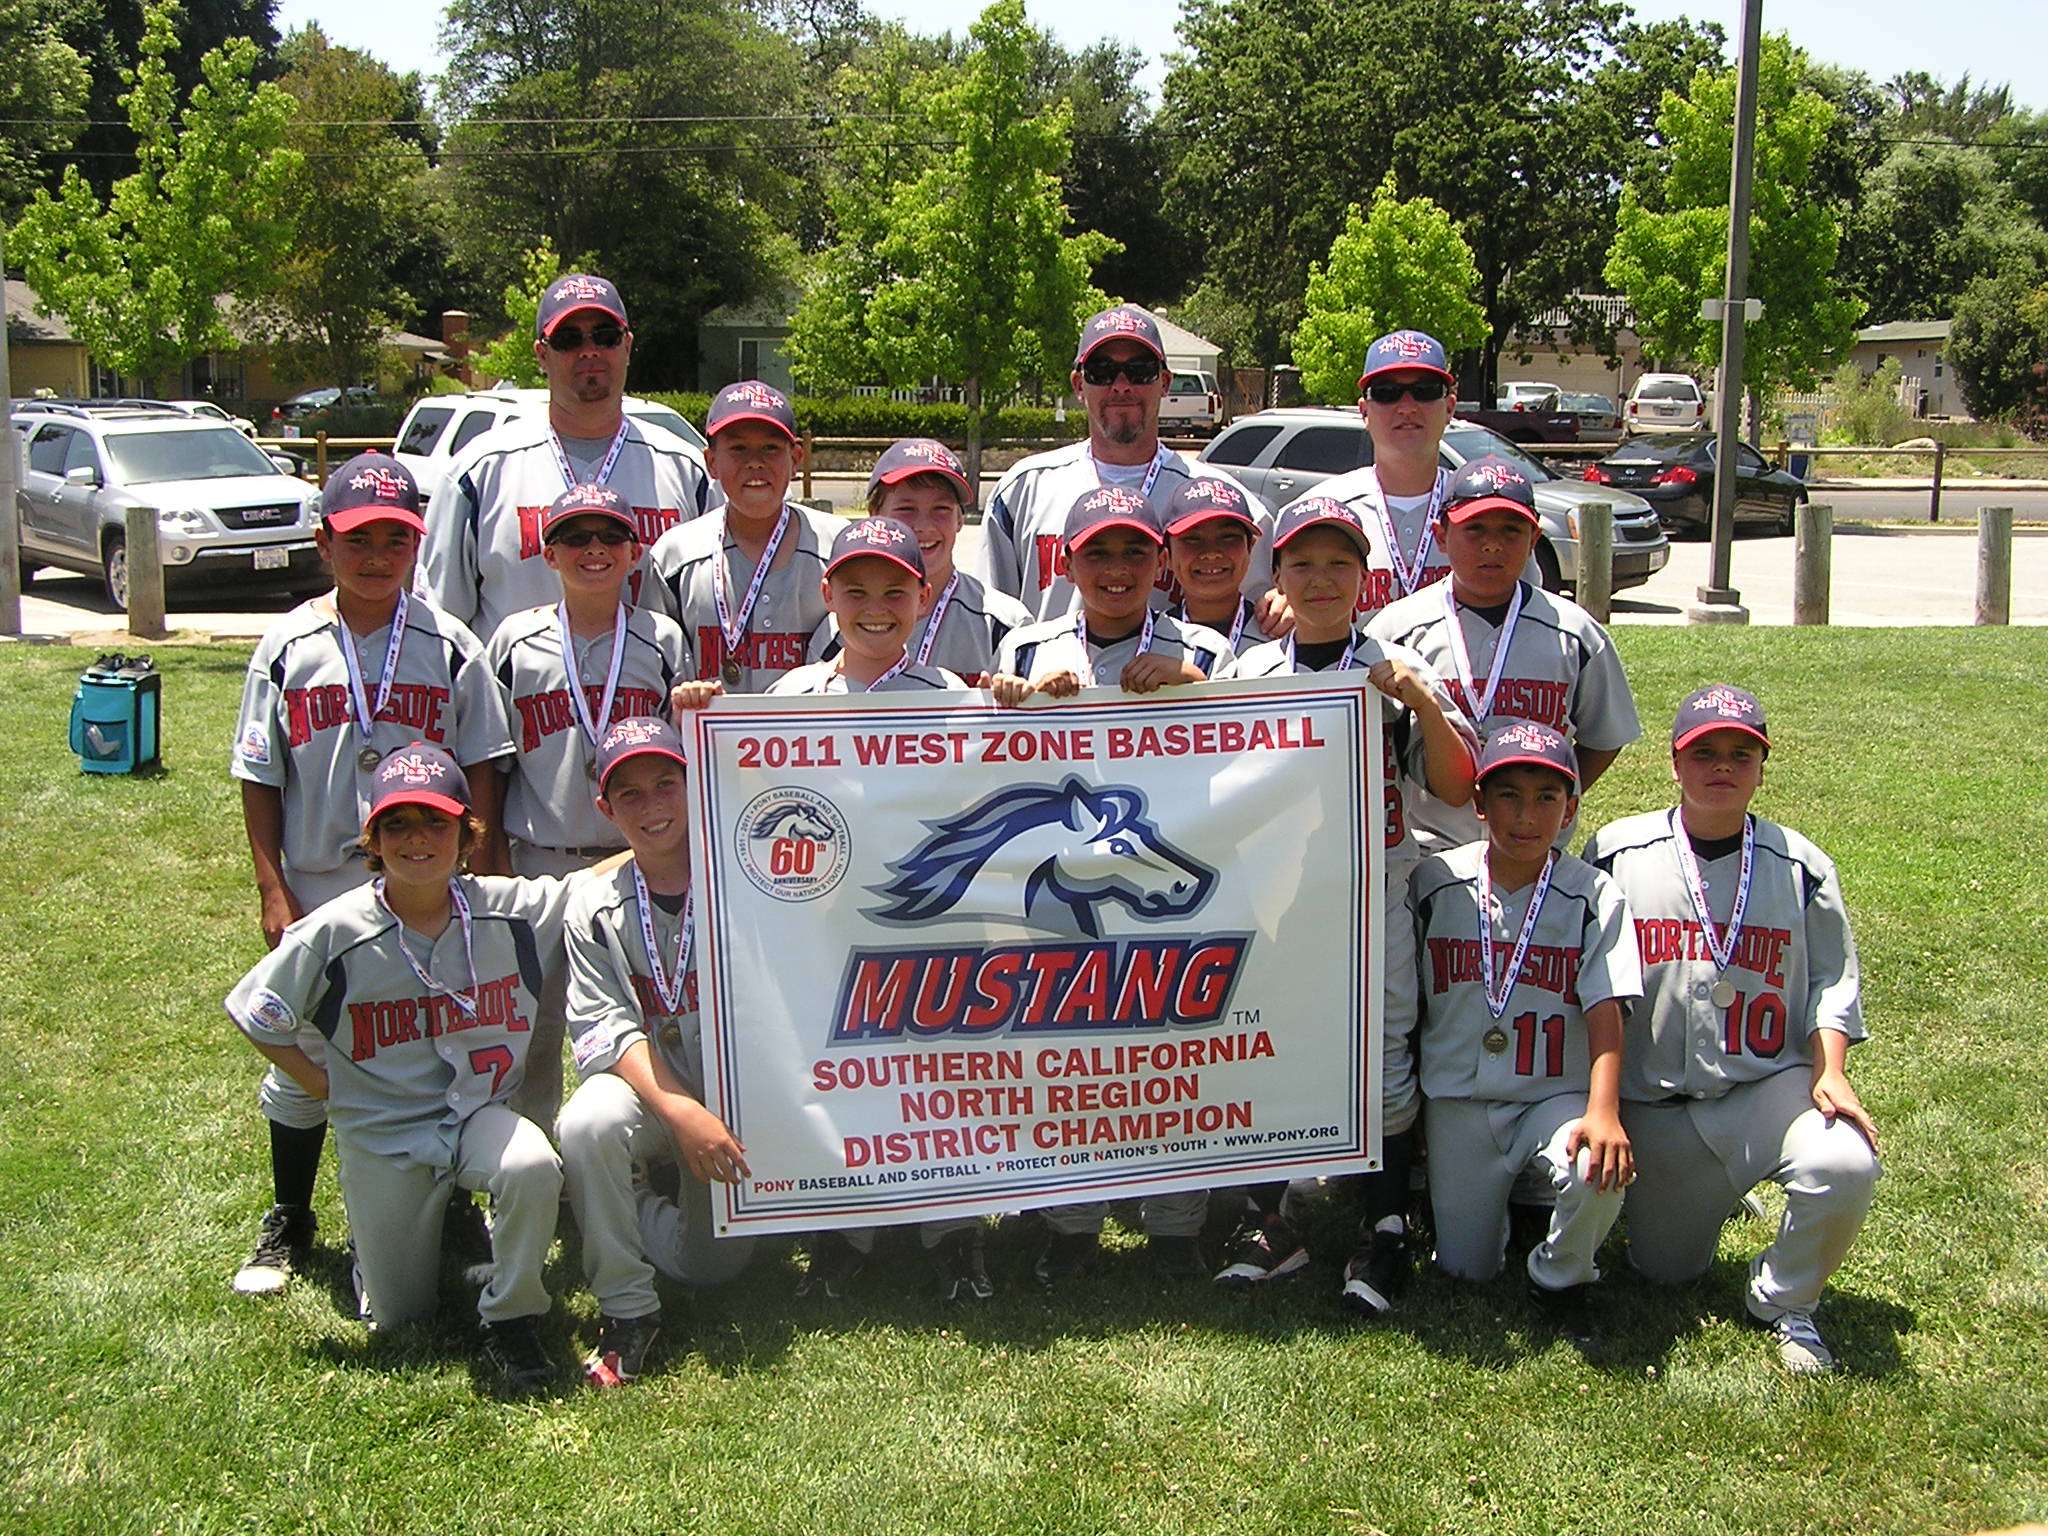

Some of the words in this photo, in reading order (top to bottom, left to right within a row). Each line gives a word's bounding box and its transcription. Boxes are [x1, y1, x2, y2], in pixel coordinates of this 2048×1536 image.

[242, 508, 281, 521] GMC
[283, 684, 450, 748] NORHSIDE
[737, 735, 841, 768] 2011
[852, 732, 969, 766] WEST
[981, 729, 1095, 763] ZONE
[1107, 716, 1326, 760] BASEBALL
[773, 791, 816, 802] BASEBALL
[838, 941, 1242, 1036] MUSTANG
[1233, 1009, 1260, 1026] TM
[1512, 1011, 1565, 1077] 11
[1724, 991, 1787, 1059] 10
[468, 1044, 514, 1098] 7
[812, 1050, 1024, 1092] SOUTHERN
[1036, 1030, 1276, 1080] CALIFORNIA
[900, 1085, 1035, 1124] NORTH
[1047, 1073, 1200, 1113] REGION
[753, 1179, 795, 1194] PONY
[799, 1176, 874, 1191] BASEBALL
[878, 1171, 908, 1185] AND
[910, 1164, 981, 1182] SOFTBALL
[996, 1156, 1057, 1173] PROTECT
[1060, 1151, 1090, 1166] OUR
[1093, 1144, 1159, 1161] NATION'S
[1161, 1139, 1208, 1154] YOUTH
[1224, 1126, 1340, 1147] WWW.PONY.ORG
[843, 1123, 1021, 1169] DISTRICT
[1031, 1101, 1254, 1150] CHAMPION
